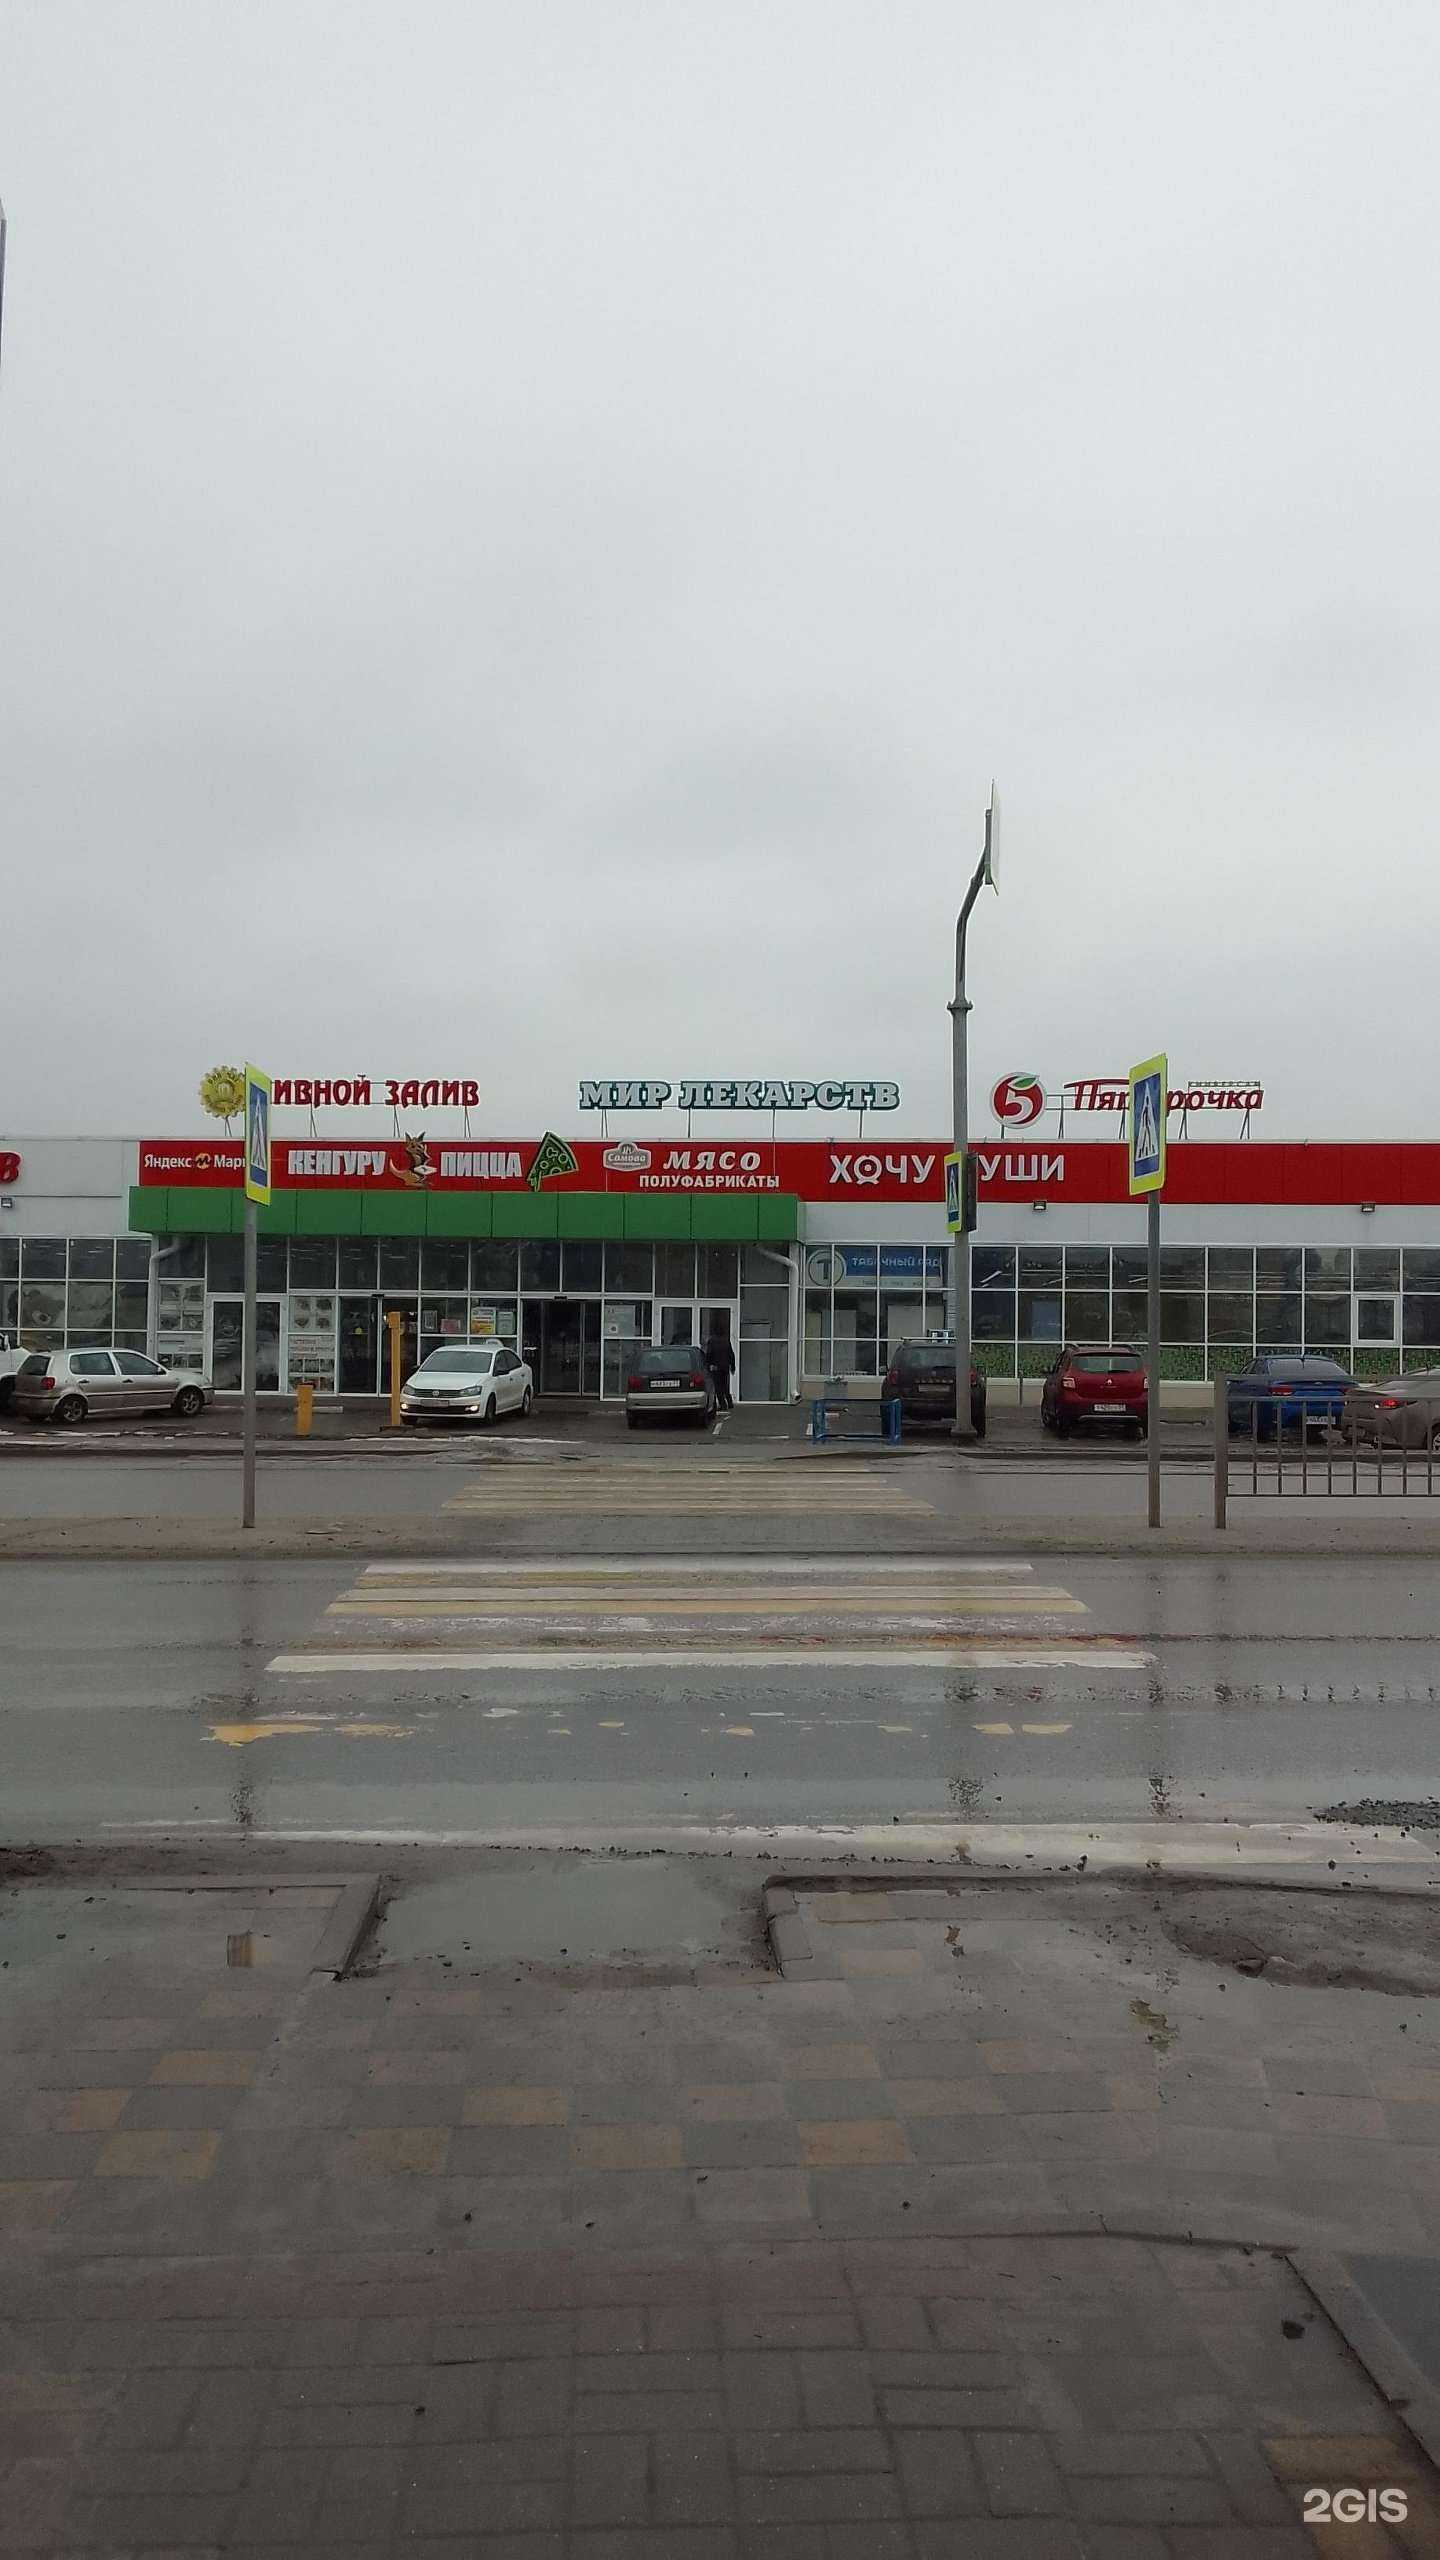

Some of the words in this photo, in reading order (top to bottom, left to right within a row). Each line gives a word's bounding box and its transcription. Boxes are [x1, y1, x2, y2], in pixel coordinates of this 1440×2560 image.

[272, 1074, 371, 1108] ИВНОЙ
[385, 1080, 480, 1108] ЗАЛИВ
[579, 1080, 672, 1109] МИР
[679, 1080, 900, 1110] ЛЕКАРСТВ
[144, 1154, 192, 1169] Яндекс
[214, 1155, 245, 1170] Мар
[288, 1150, 386, 1176] КЕНГУРУ
[440, 1151, 522, 1179] ПИЦЦА
[663, 1151, 761, 1171] МЯСО
[829, 1154, 936, 1185] ХОЧУ
[978, 1154, 1065, 1182] УШИ
[639, 1175, 780, 1188] ПОЛУФАБРИКАТЫ
[851, 1256, 915, 1267] ТАБЧНЫЙ
